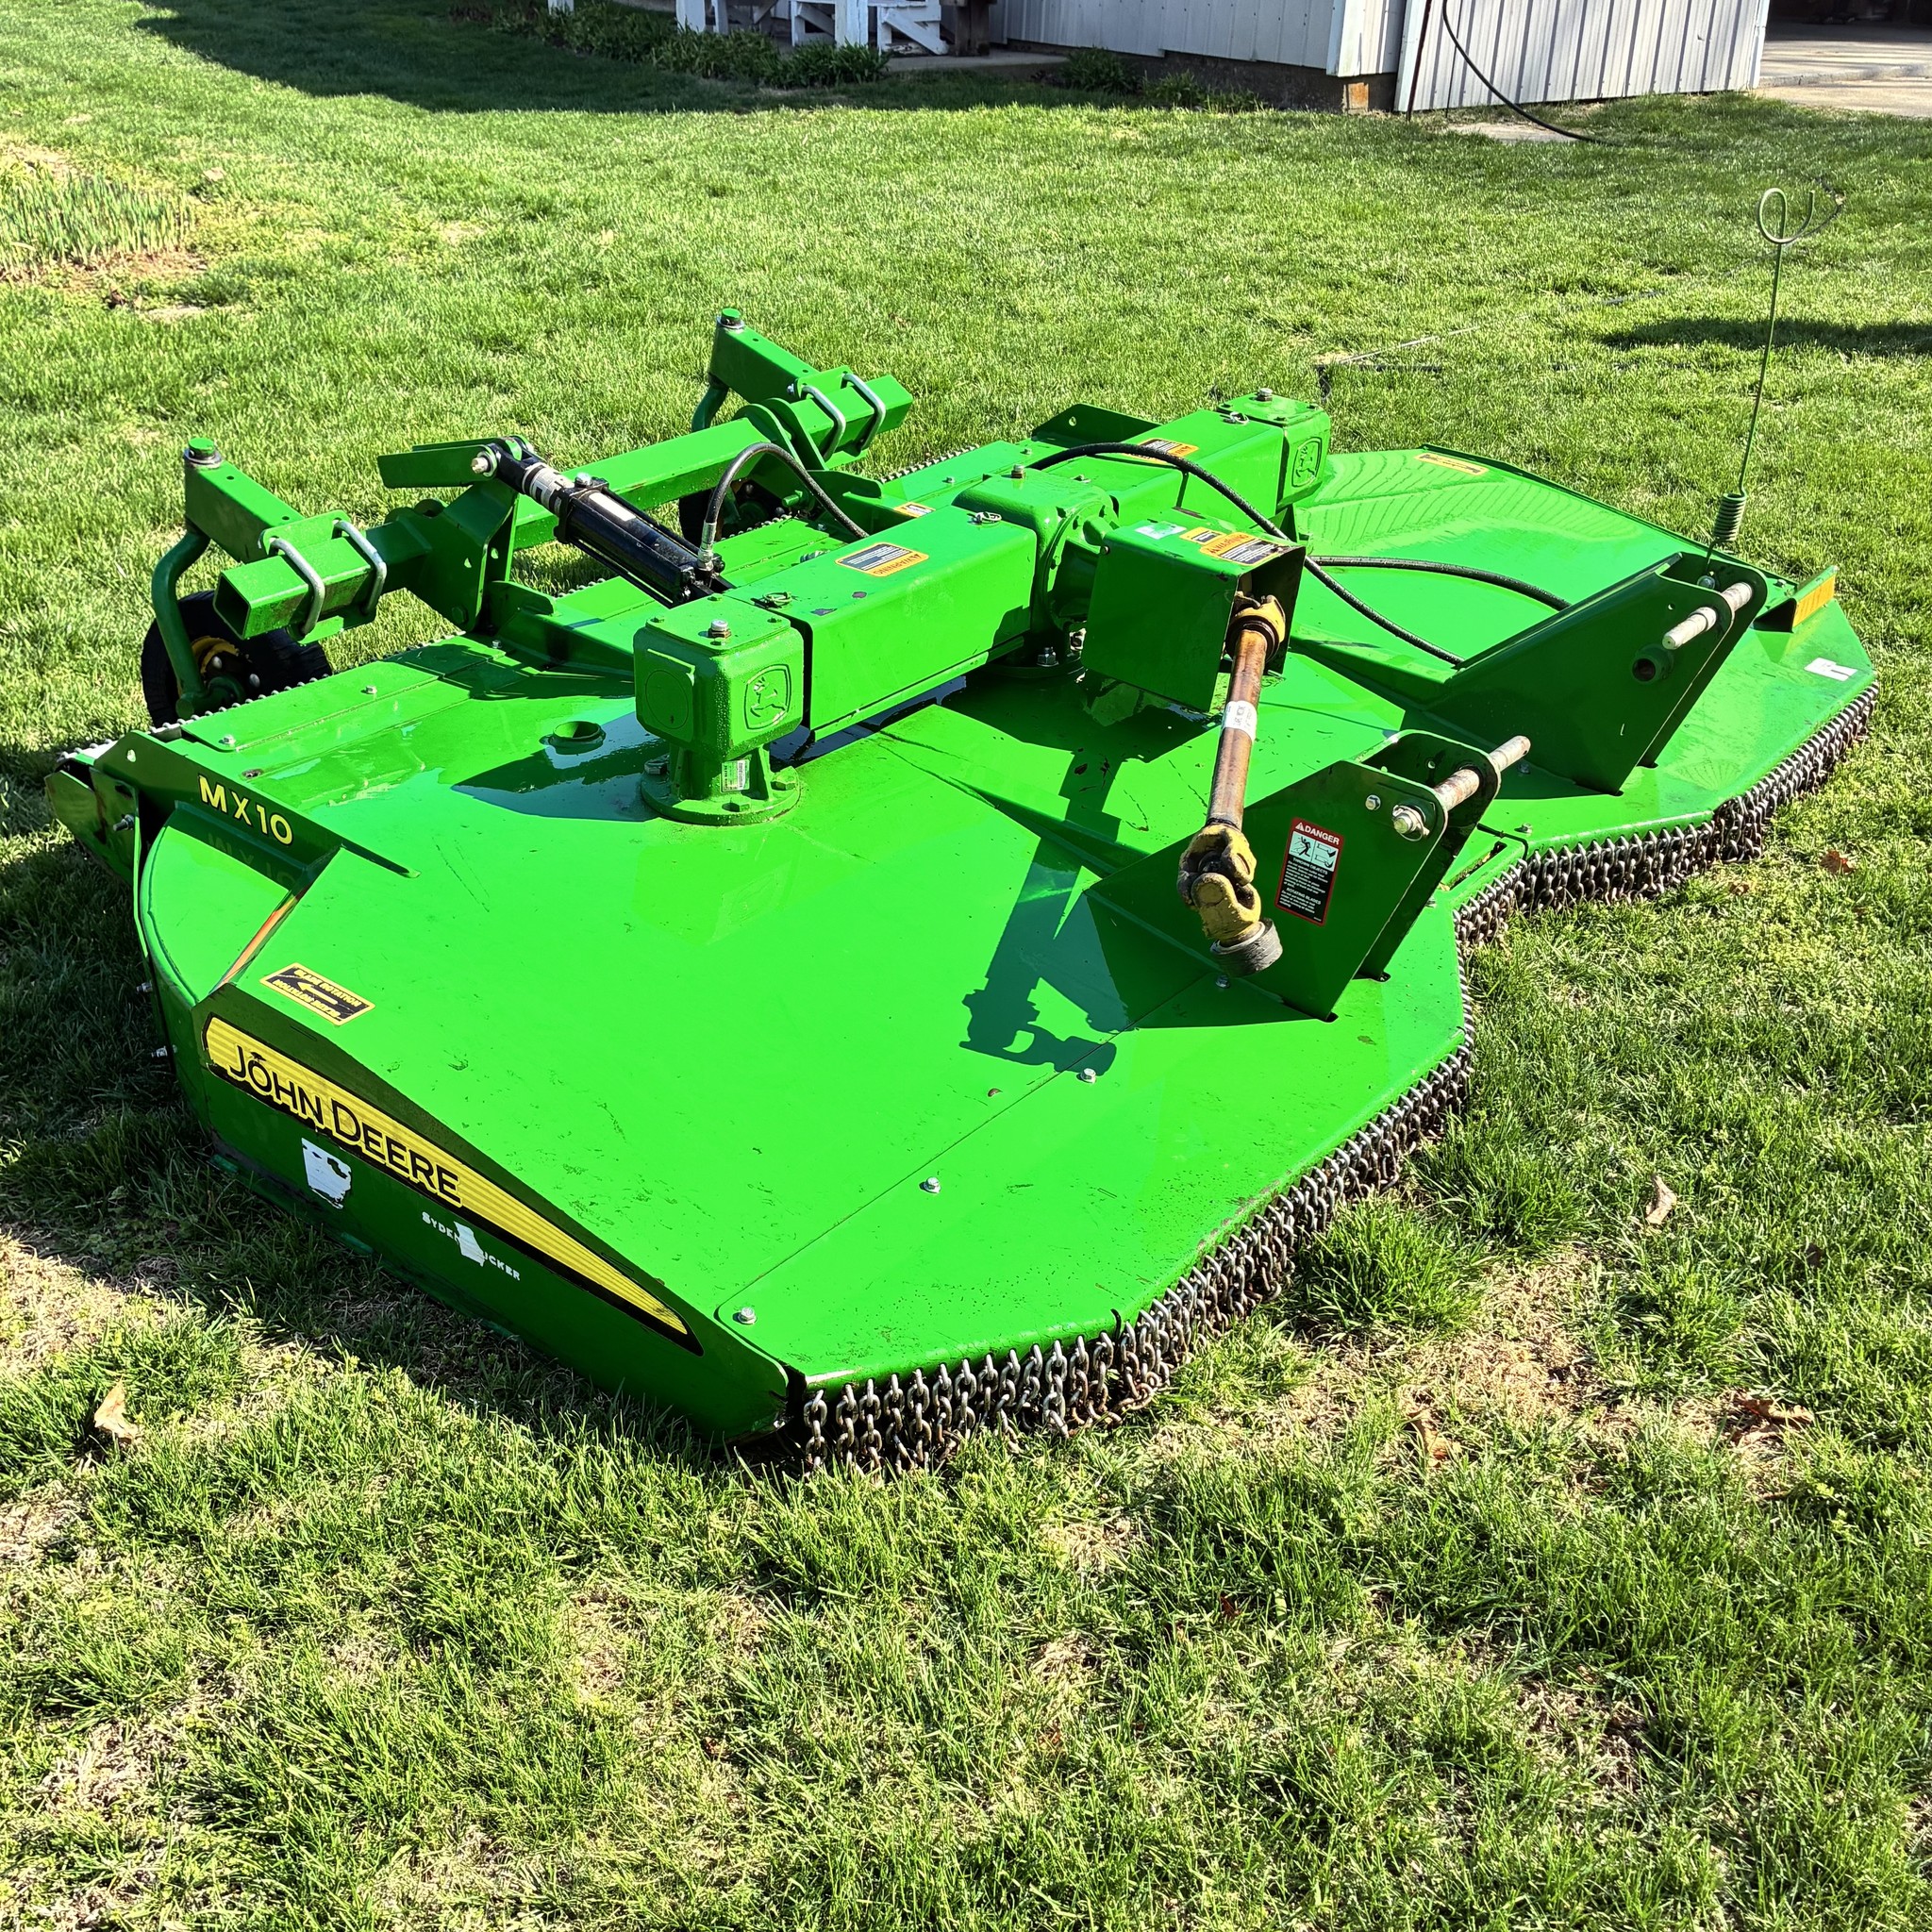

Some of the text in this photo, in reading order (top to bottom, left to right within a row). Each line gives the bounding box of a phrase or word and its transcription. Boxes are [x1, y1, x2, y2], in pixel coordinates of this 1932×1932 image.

[199, 774, 292, 844] MX10
[1305, 825, 1340, 845] DANGER
[319, 983, 362, 1008] ROTATION
[230, 1044, 461, 1205] JOHN DEERE
